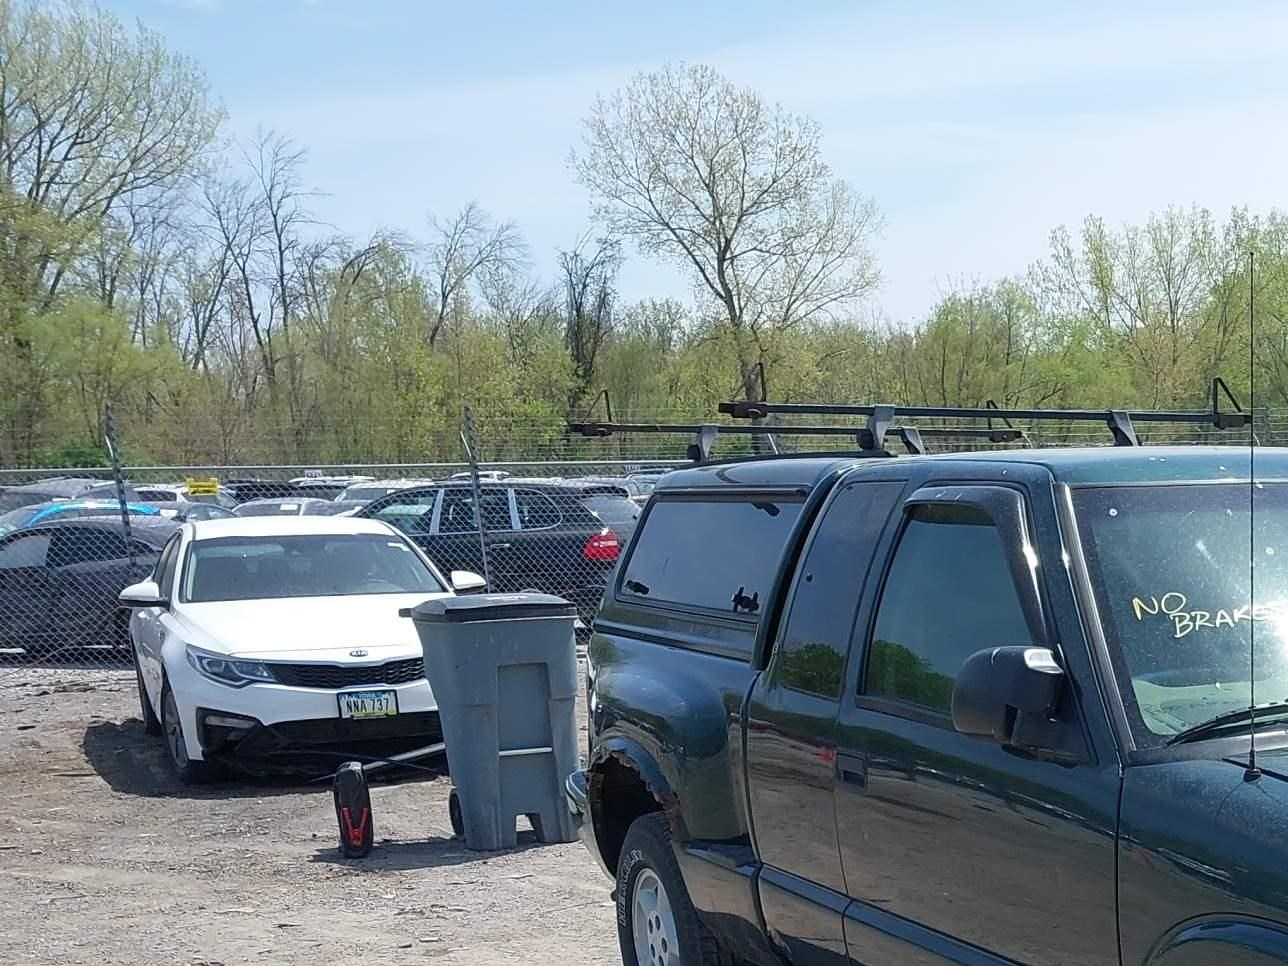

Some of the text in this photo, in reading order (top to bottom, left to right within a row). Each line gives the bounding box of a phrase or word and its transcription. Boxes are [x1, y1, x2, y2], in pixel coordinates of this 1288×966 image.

[1132, 592, 1187, 621] NO
[346, 697, 389, 713] NNA 737
